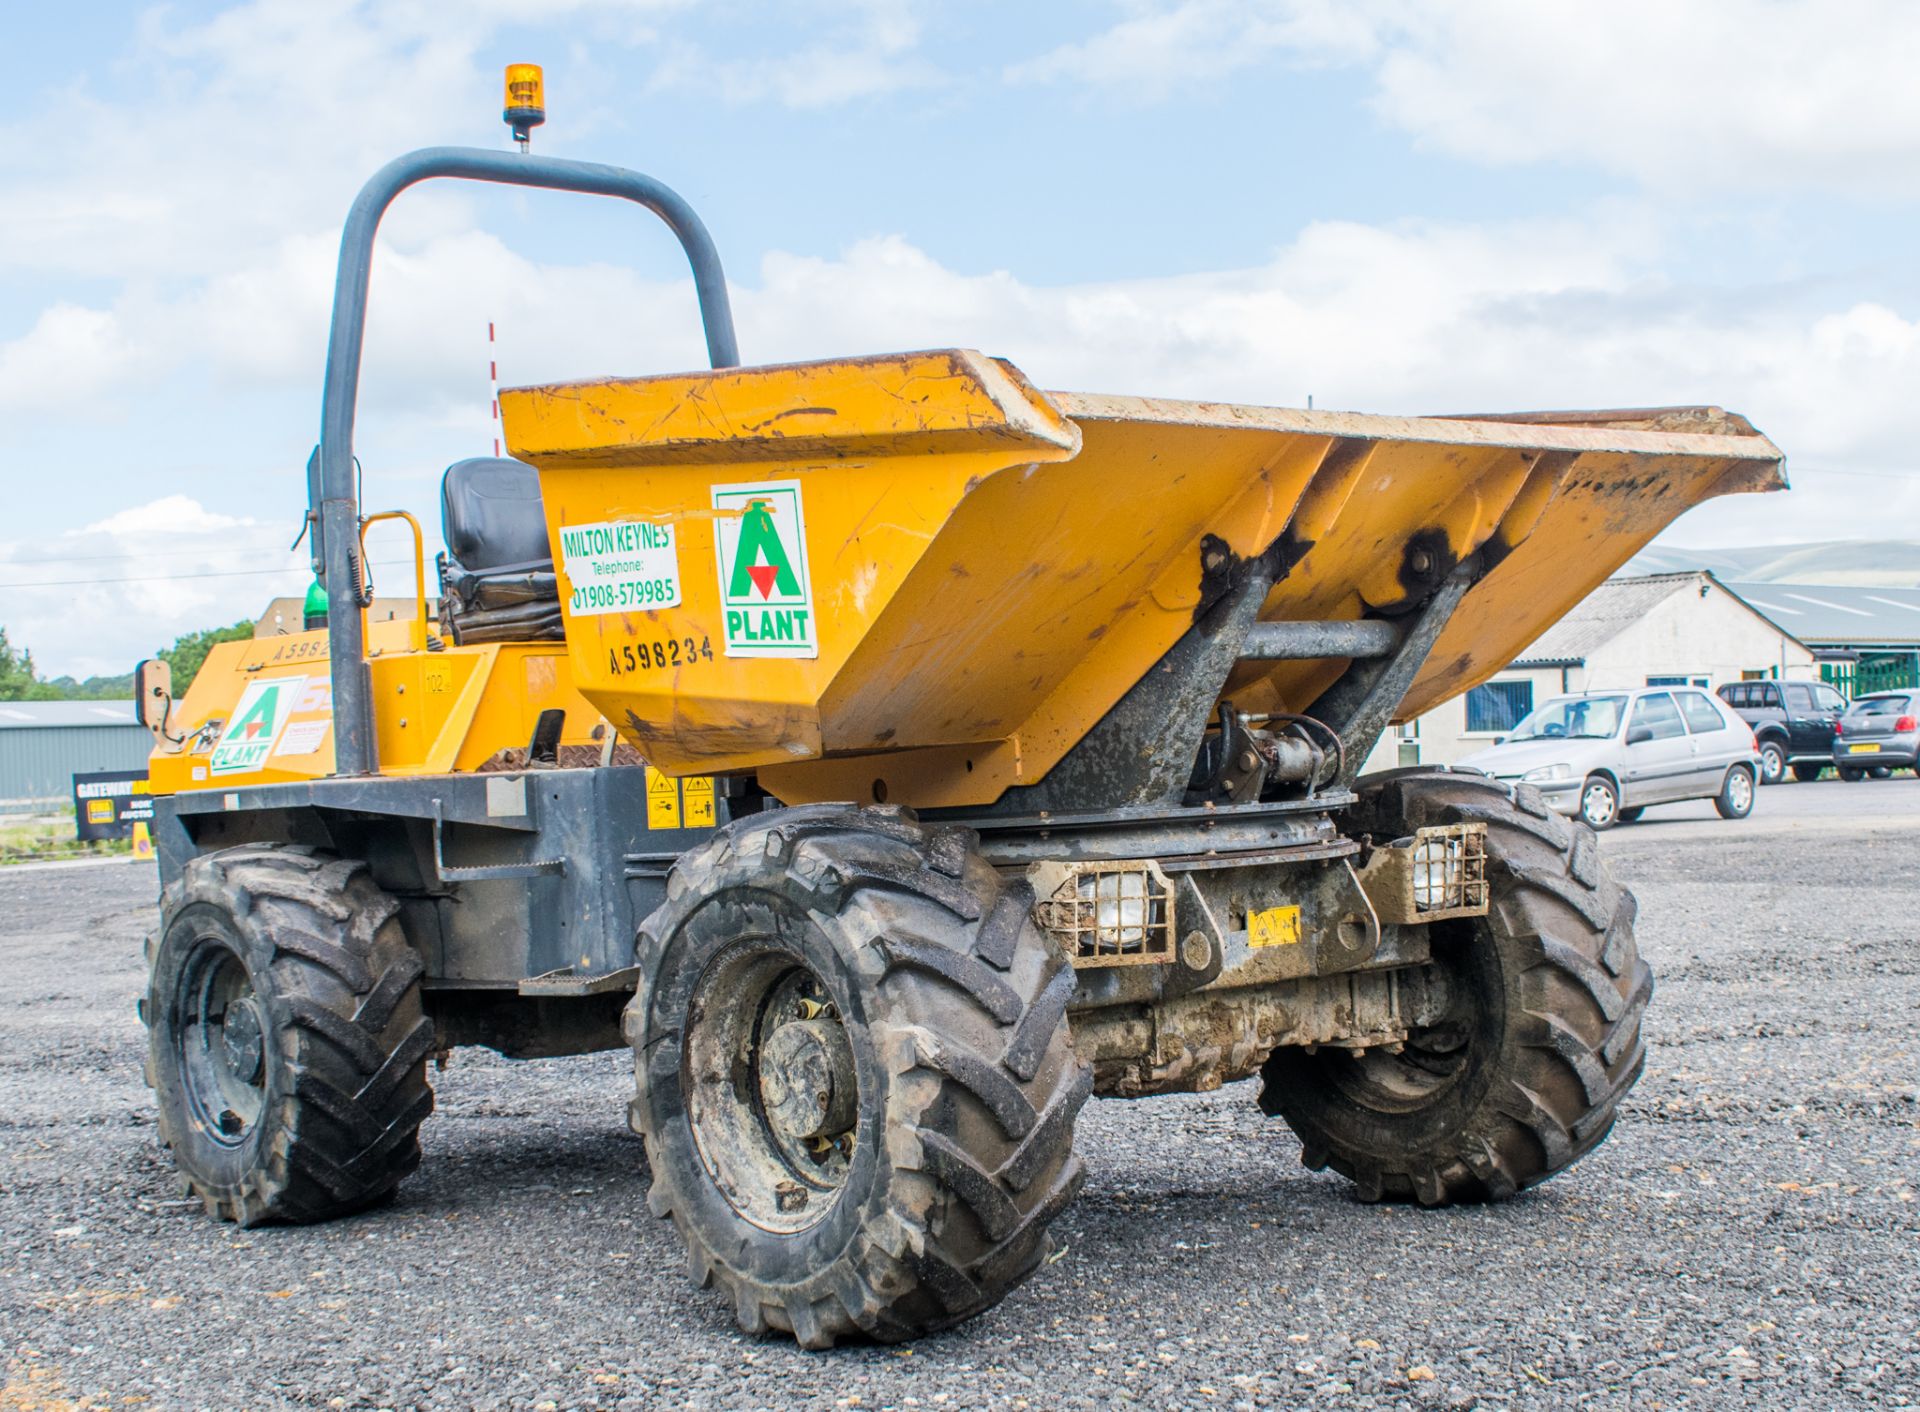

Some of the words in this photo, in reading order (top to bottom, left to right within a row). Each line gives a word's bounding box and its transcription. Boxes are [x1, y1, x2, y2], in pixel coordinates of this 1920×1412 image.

[563, 527, 614, 559] MILTON
[617, 522, 671, 552] KEYNES
[591, 560, 645, 577] Telephone:
[573, 578, 675, 609] 01908-579985
[726, 610, 809, 641] PLANT
[272, 640, 331, 660] A5982
[609, 636, 714, 676] A598234
[212, 744, 270, 767] PLANT
